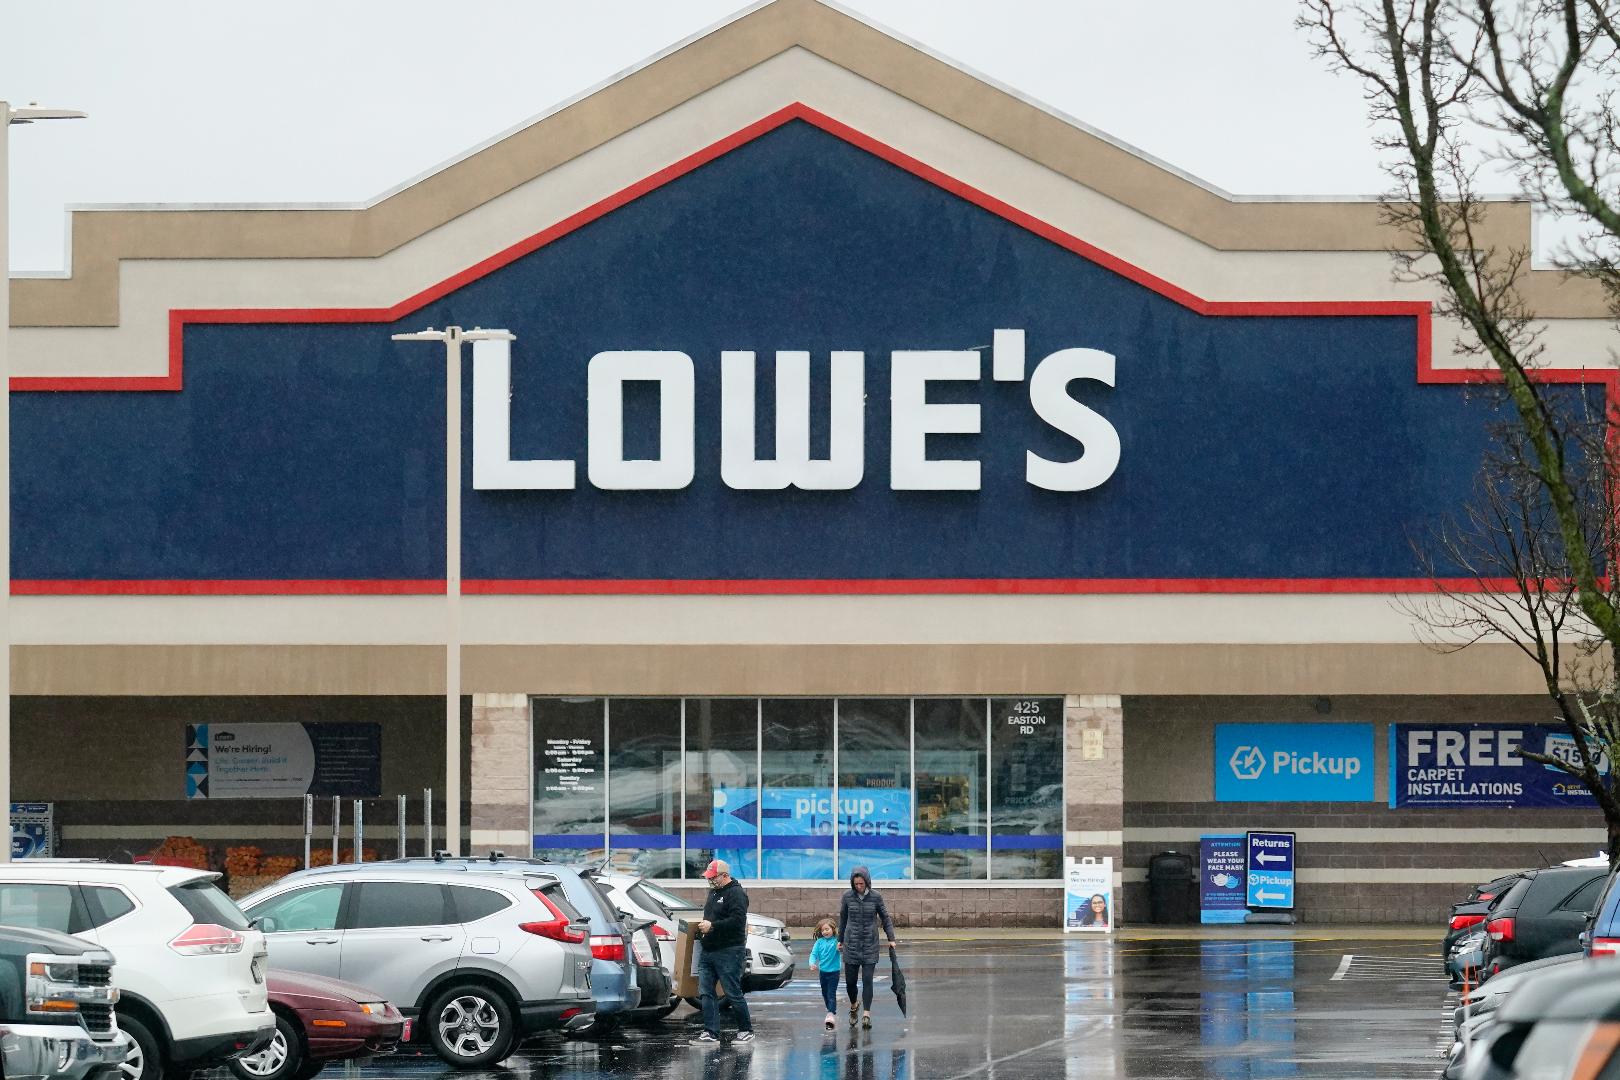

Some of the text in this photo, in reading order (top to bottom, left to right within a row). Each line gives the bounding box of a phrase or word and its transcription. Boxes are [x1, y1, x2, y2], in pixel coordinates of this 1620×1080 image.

[473, 328, 1121, 492] LOWE'S
[1013, 701, 1040, 714] 425
[1007, 715, 1046, 725] EASTON
[1020, 726, 1034, 735] RD
[215, 744, 272, 754] We're Hiring!
[1408, 730, 1523, 767] FREE
[1552, 746, 1602, 765] $150
[1273, 751, 1361, 780] Pickup
[1408, 769, 1465, 781] CARPET
[1408, 783, 1523, 796] INSTALLATIONS
[796, 793, 874, 820] pickup
[810, 815, 900, 836] lockers
[1252, 838, 1290, 848] Returns
[1260, 876, 1292, 887] Pickup
